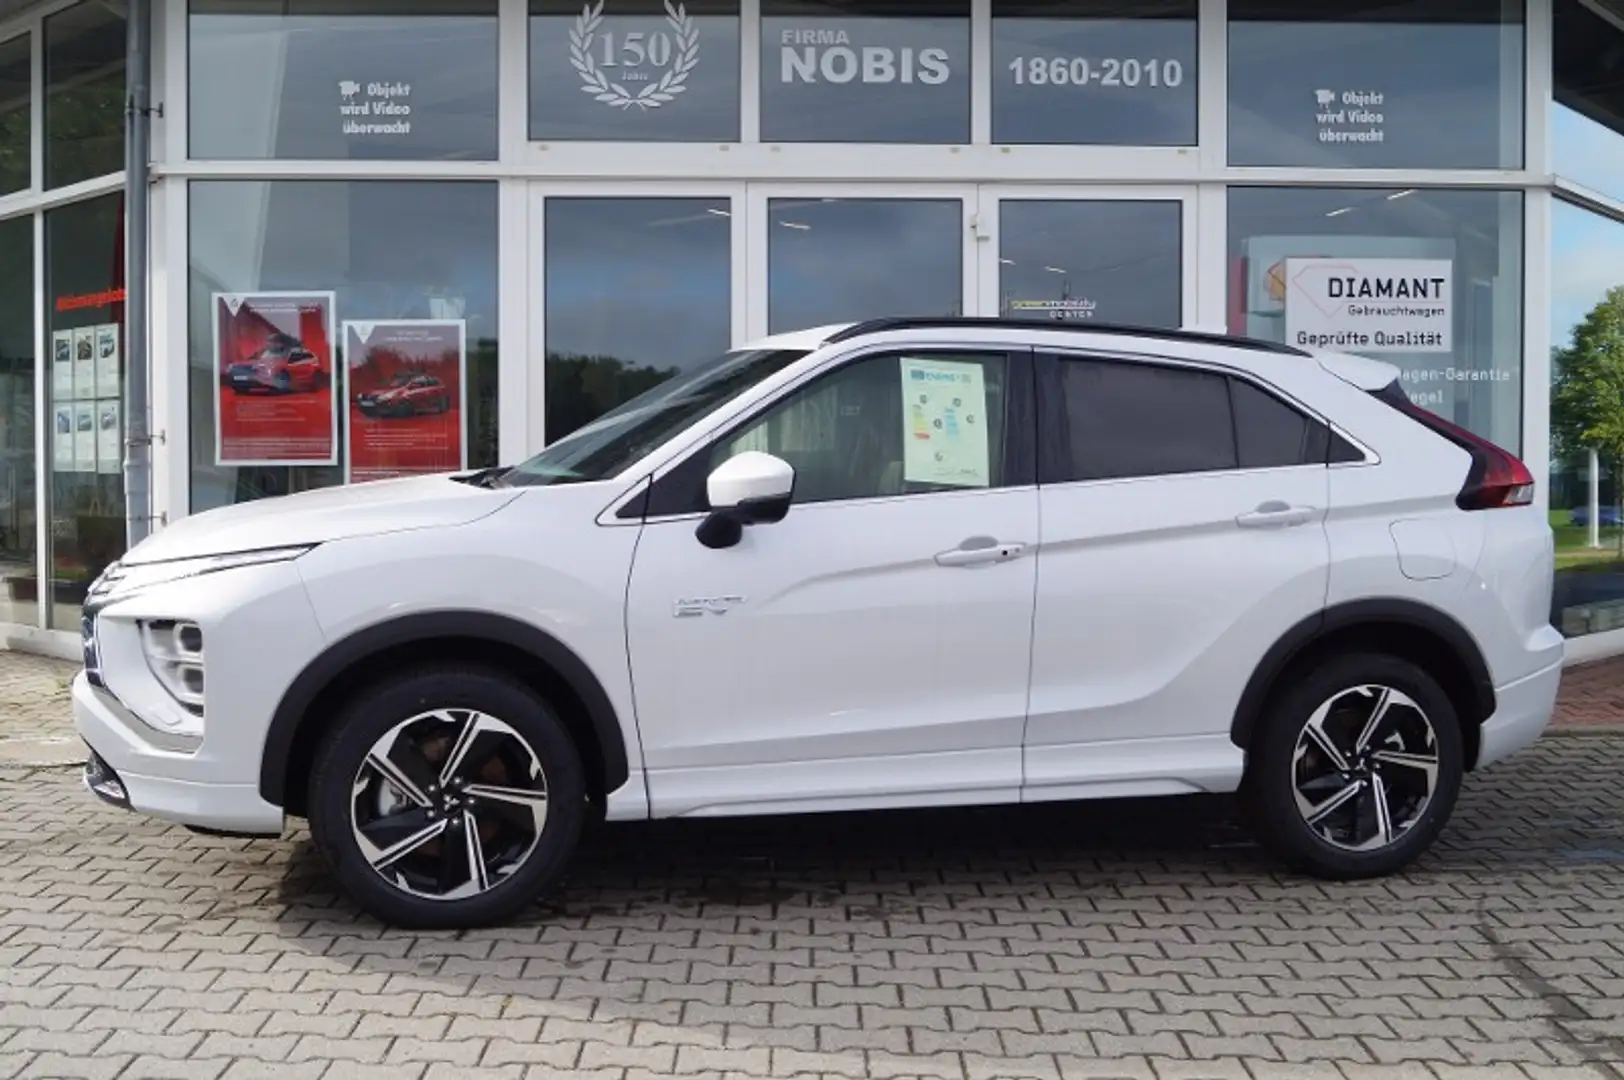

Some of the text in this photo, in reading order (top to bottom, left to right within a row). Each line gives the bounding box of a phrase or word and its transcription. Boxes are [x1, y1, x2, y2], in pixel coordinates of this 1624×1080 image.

[781, 29, 849, 44] FIRMA
[600, 32, 671, 67] 150
[781, 46, 950, 84] NOBIS
[1008, 57, 1183, 87] 1860-2010
[340, 101, 369, 115] wird
[1316, 109, 1384, 123] wird Video
[1328, 277, 1445, 299] DIAMANT
[1348, 304, 1445, 318] Gebrauchtwagen
[1297, 330, 1442, 348] Geprüfte Qualität
[1401, 367, 1511, 384] agen-Garantie
